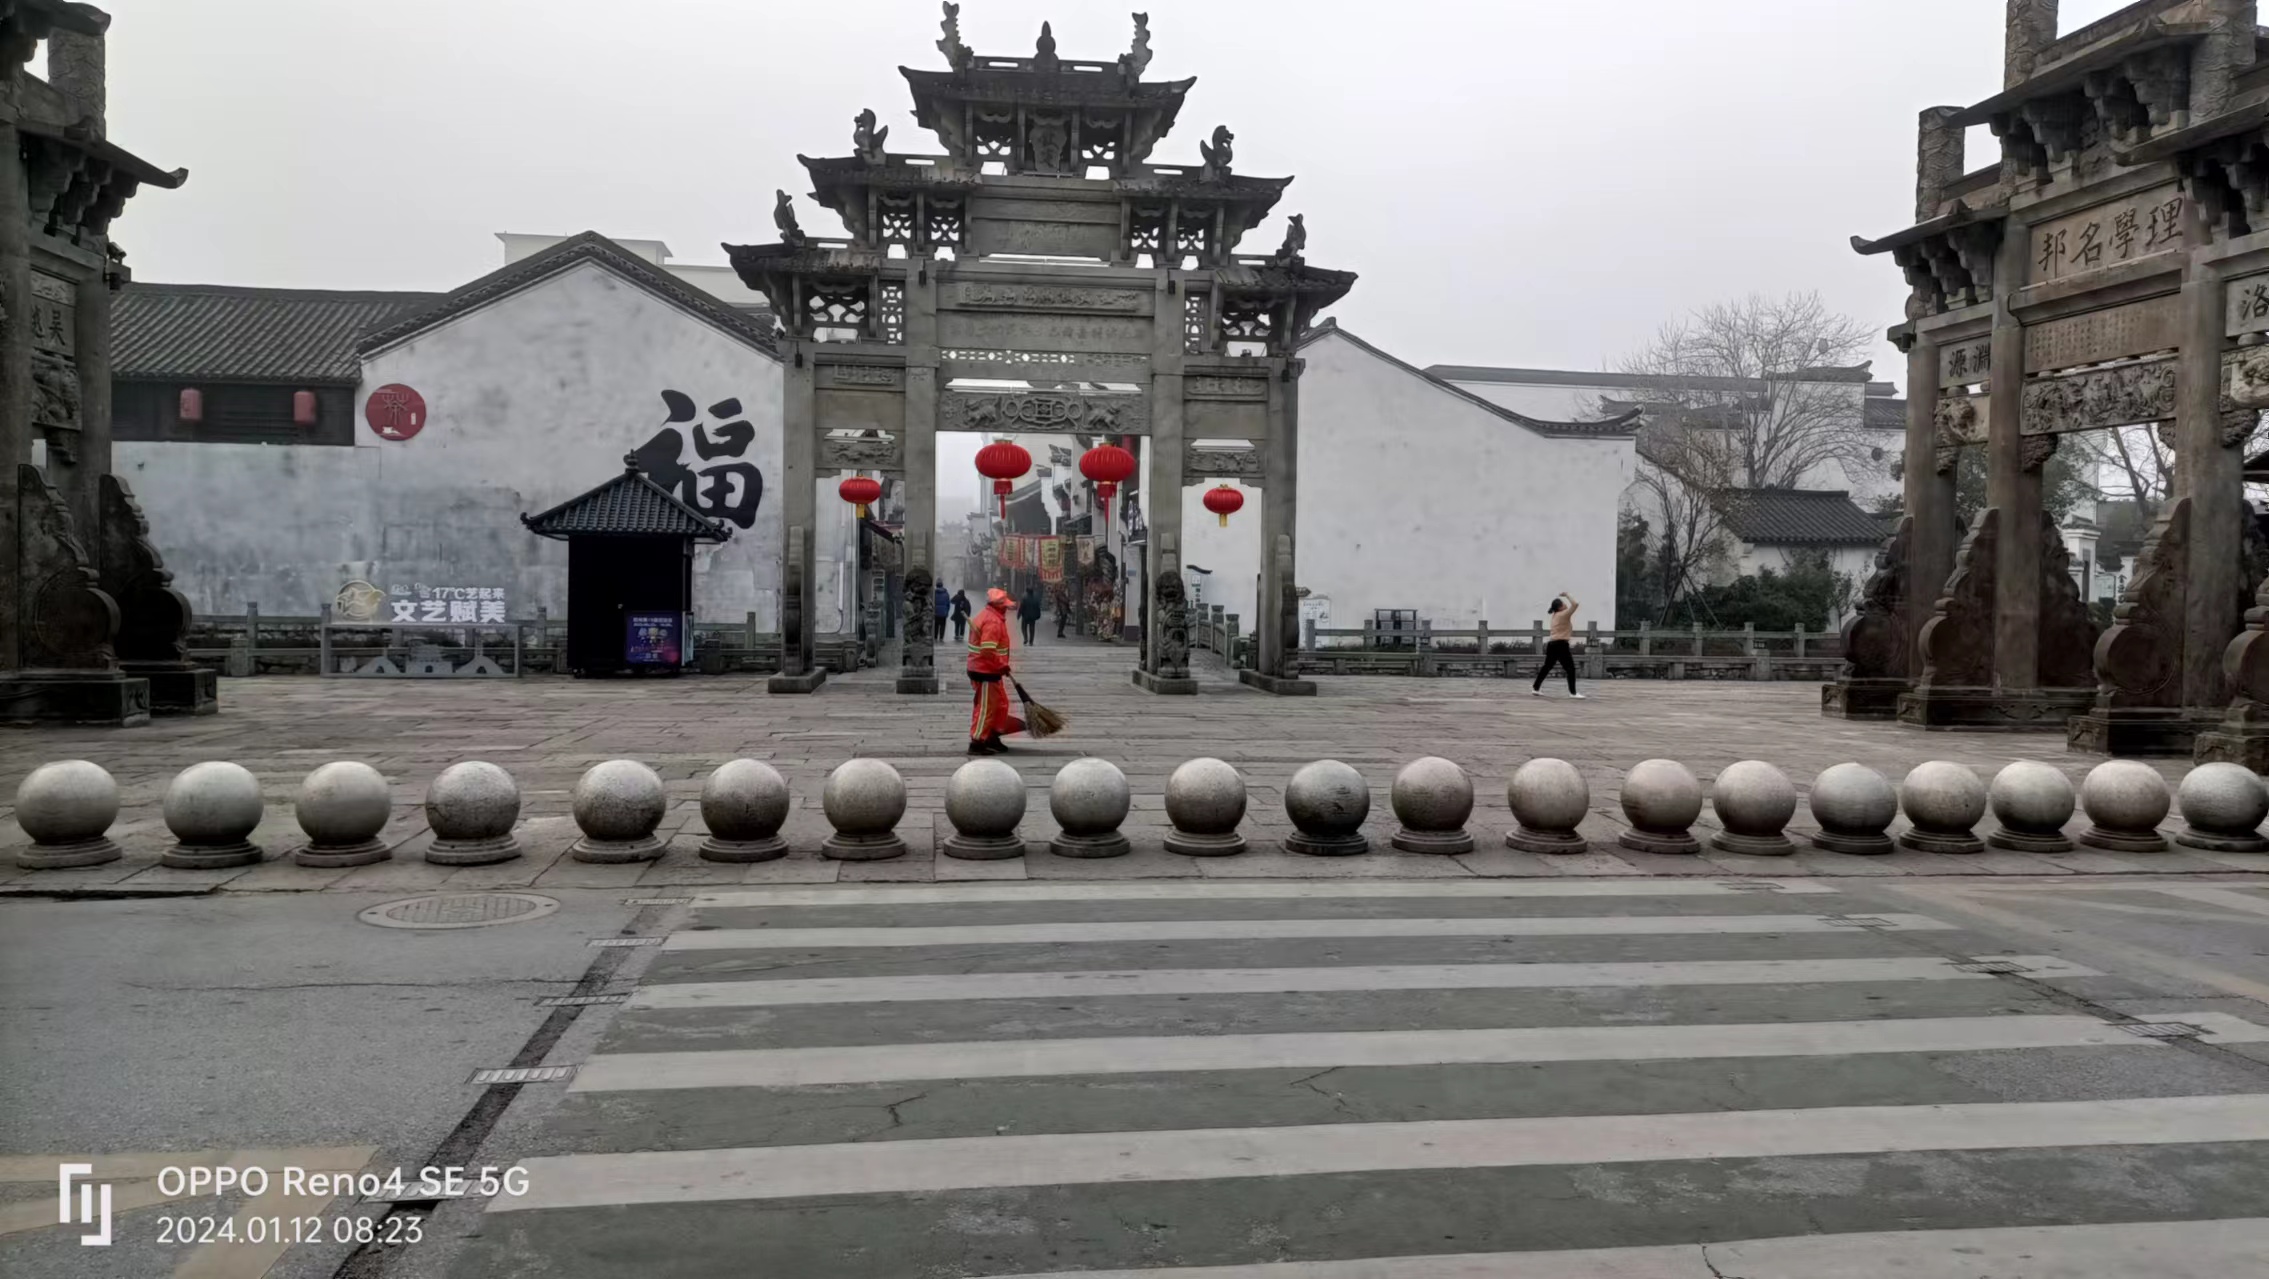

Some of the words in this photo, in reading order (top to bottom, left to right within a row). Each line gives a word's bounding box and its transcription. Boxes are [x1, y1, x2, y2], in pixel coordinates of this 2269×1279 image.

[624, 389, 763, 529] 福
[391, 599, 506, 623] 文艺赋美
